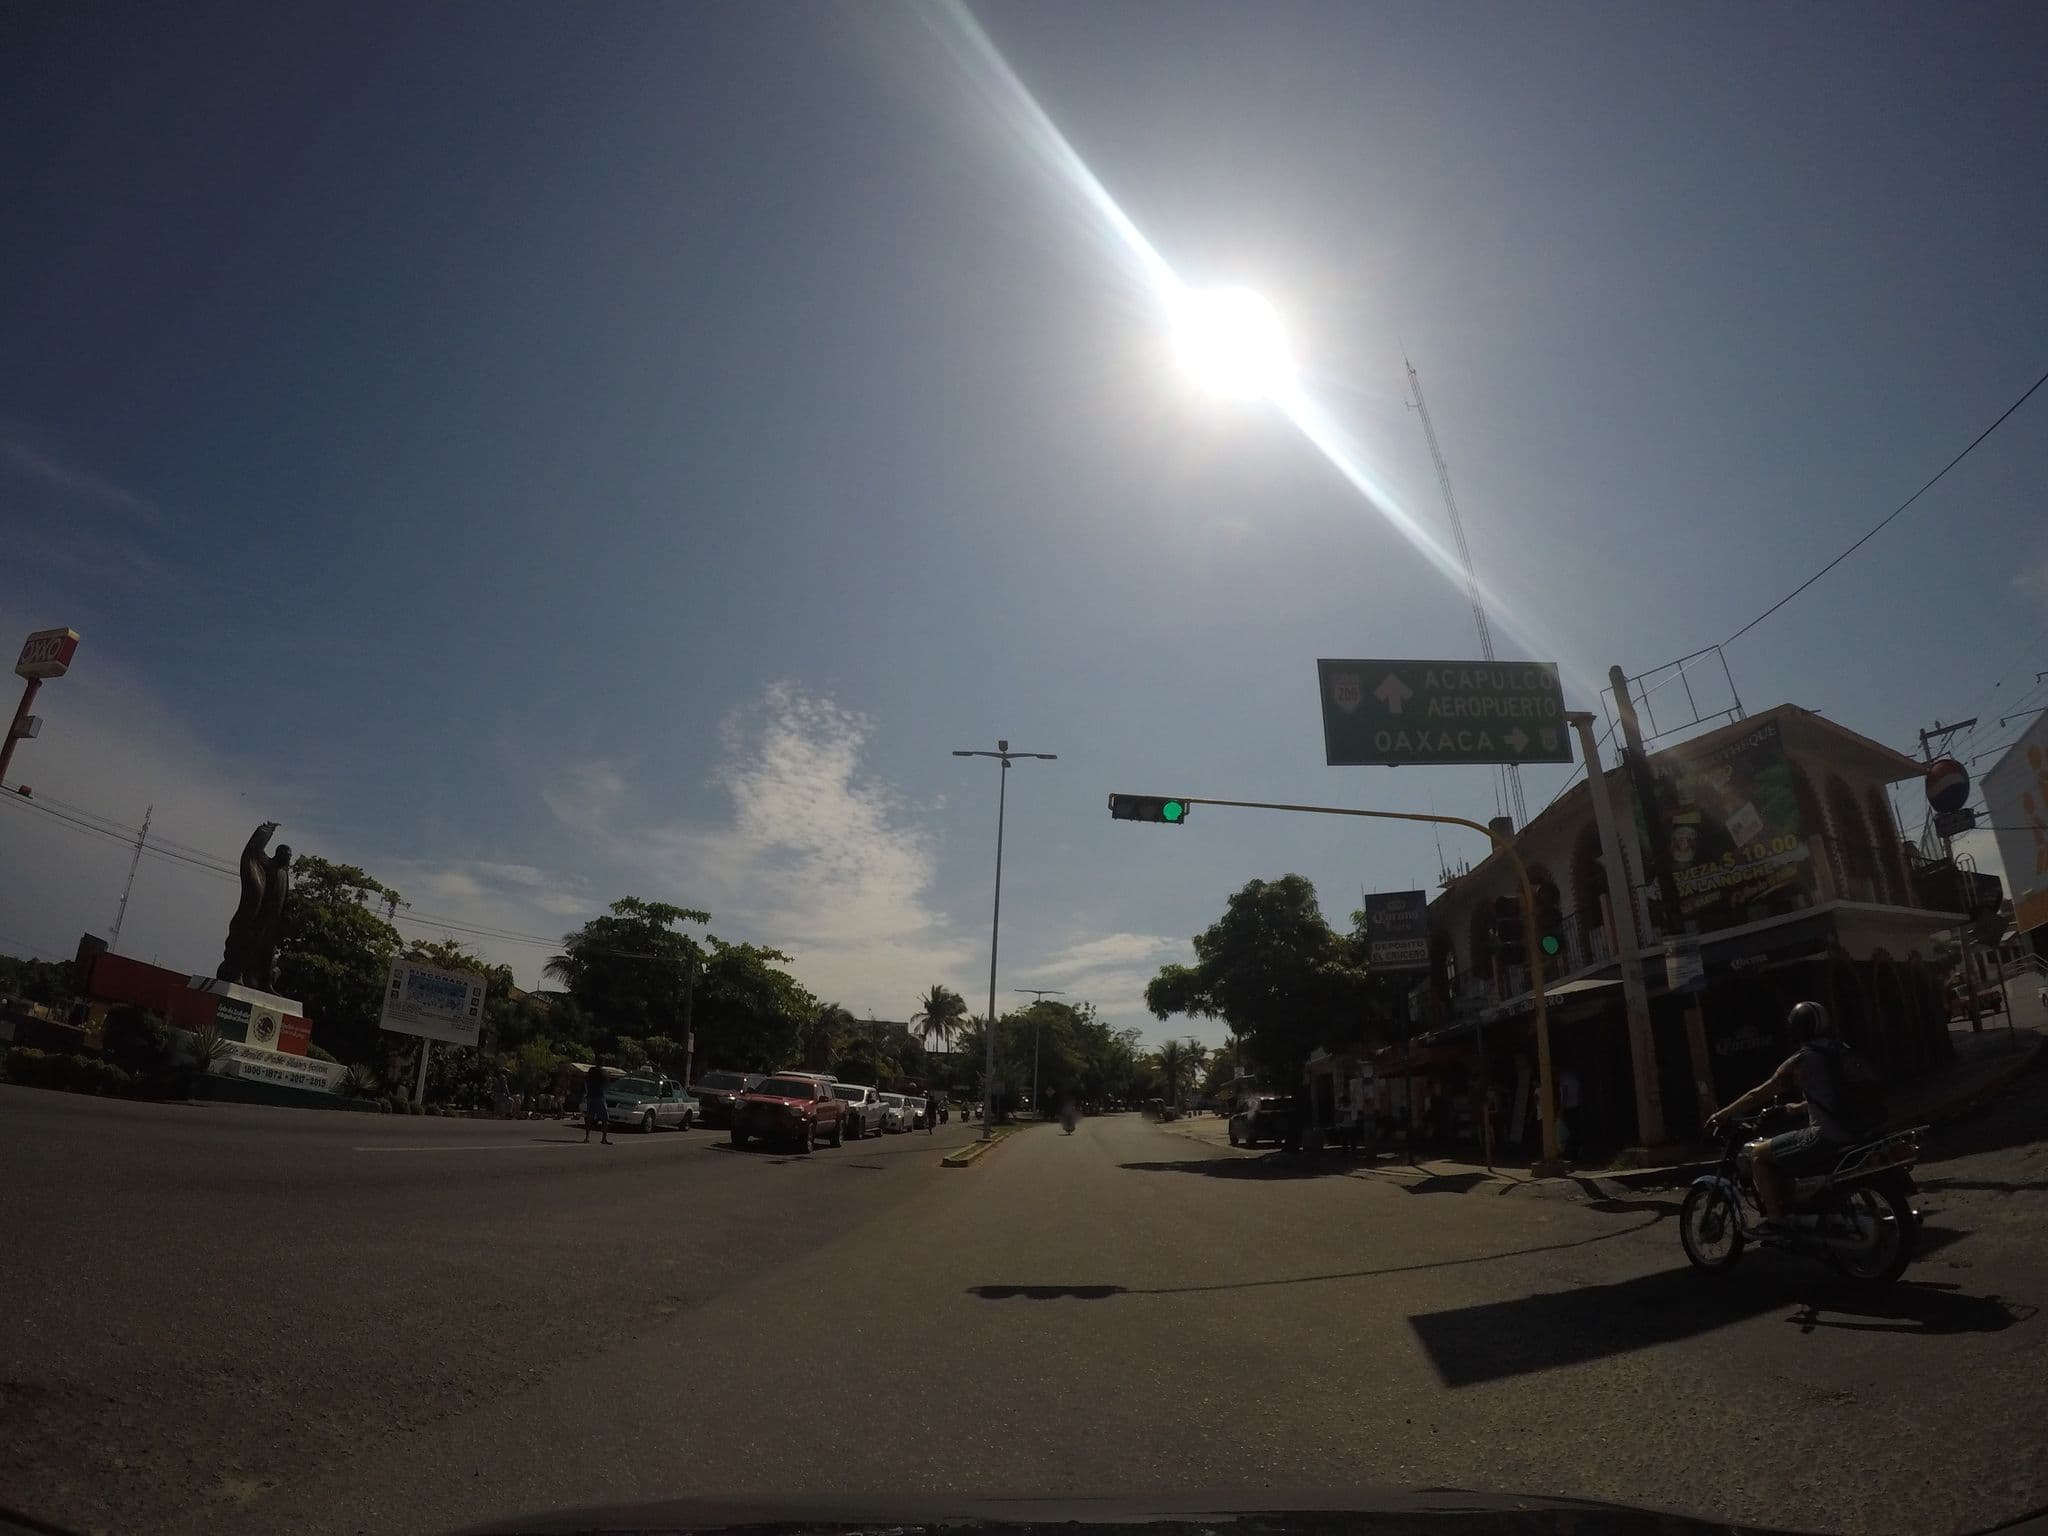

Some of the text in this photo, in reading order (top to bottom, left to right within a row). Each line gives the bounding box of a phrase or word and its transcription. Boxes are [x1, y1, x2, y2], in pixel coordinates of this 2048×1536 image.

[22, 638, 61, 663] OXXO
[1425, 669, 1555, 690] ACAPULCO
[1427, 697, 1557, 718] AEROPUERTO
[1374, 730, 1495, 752] OAXACA
